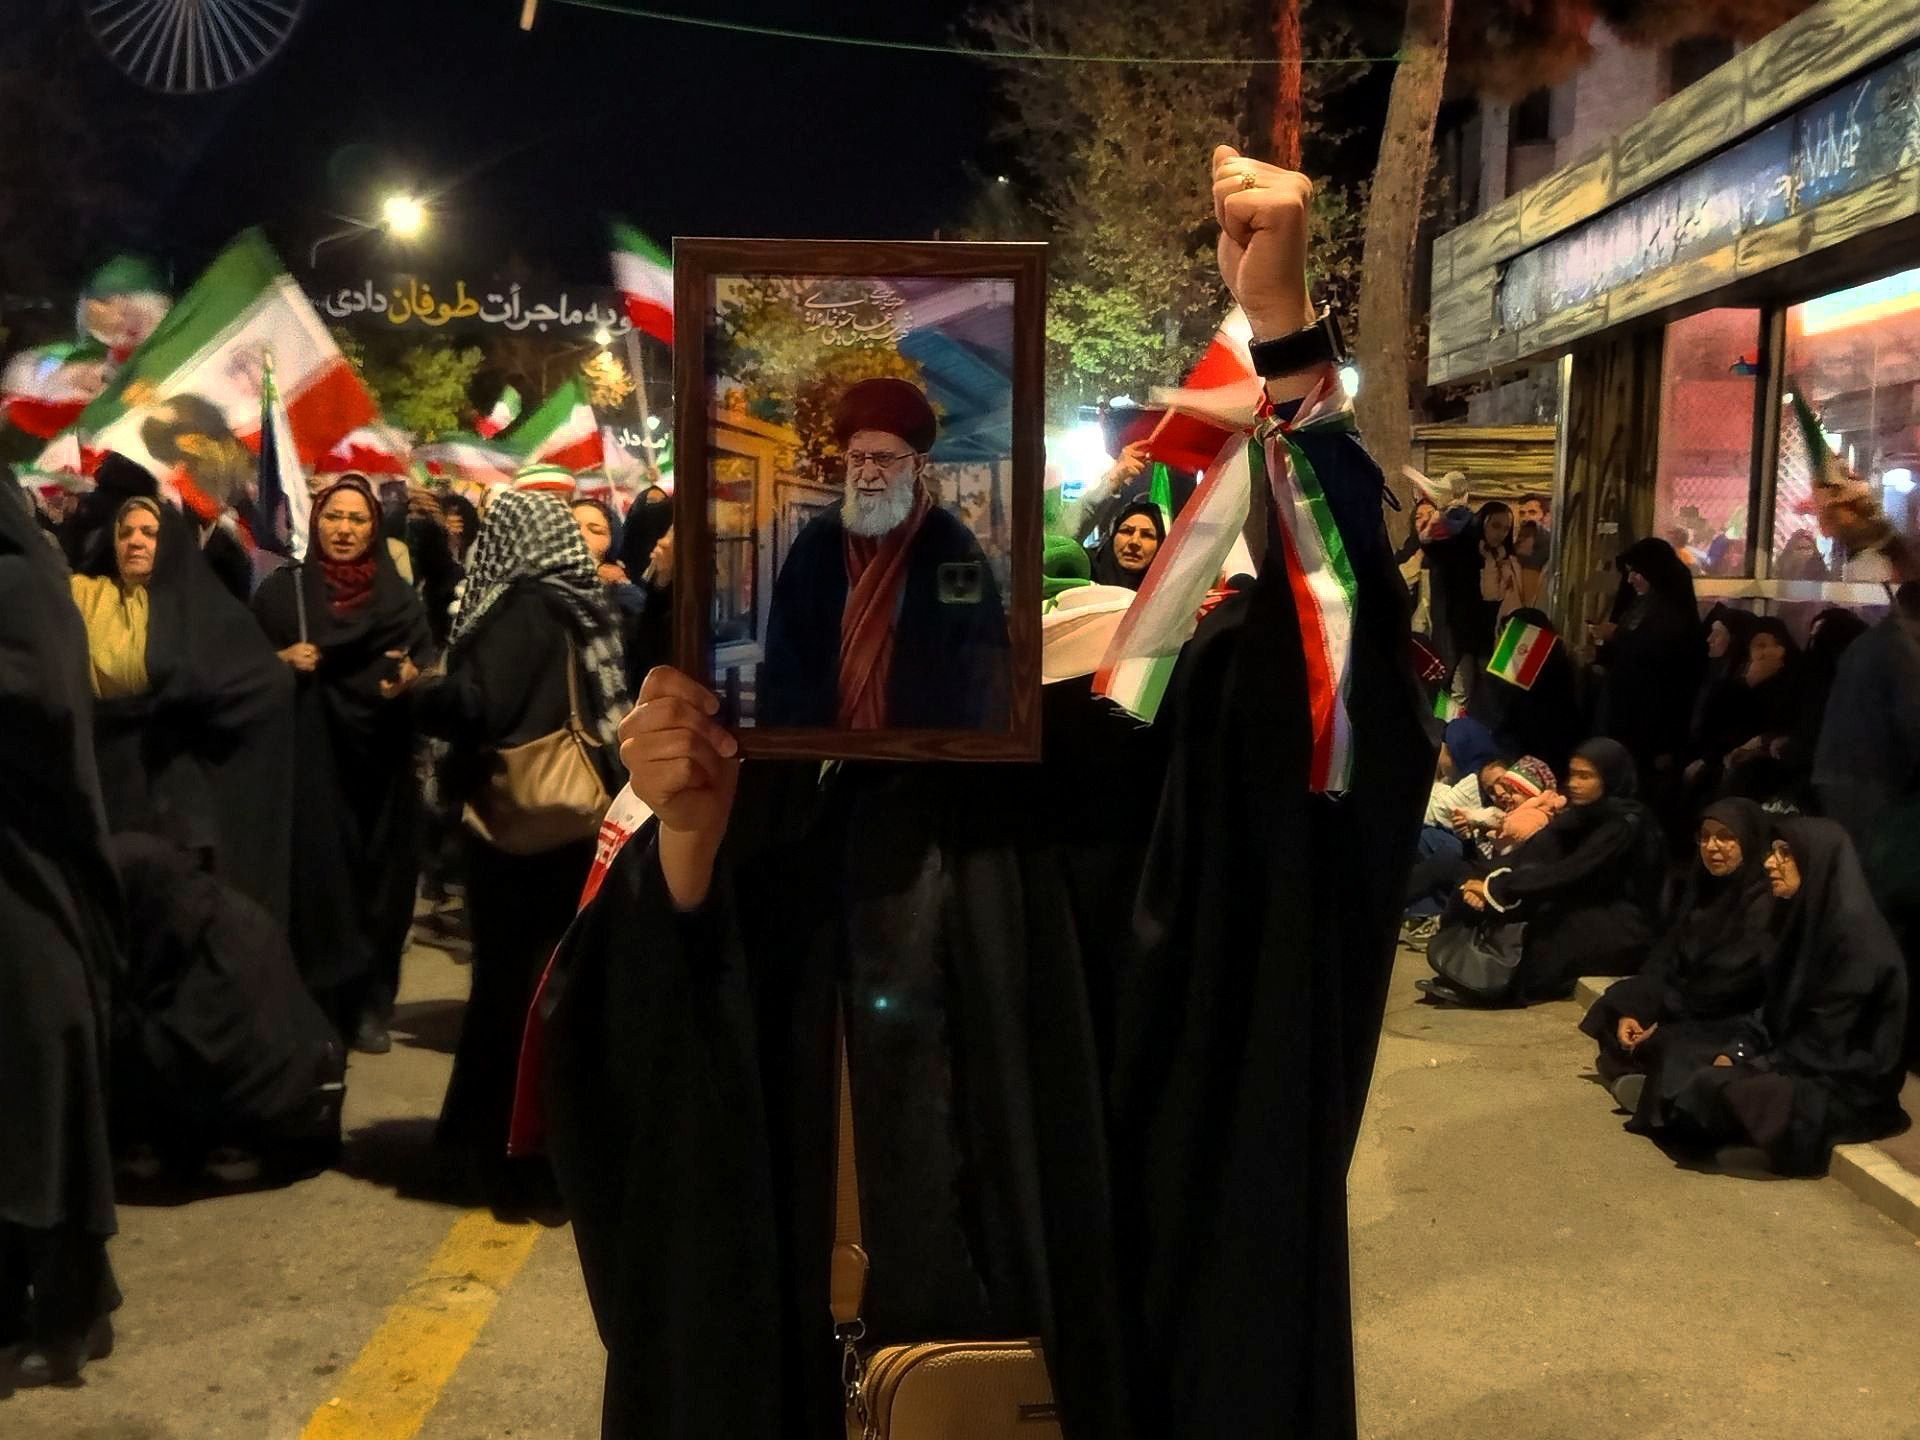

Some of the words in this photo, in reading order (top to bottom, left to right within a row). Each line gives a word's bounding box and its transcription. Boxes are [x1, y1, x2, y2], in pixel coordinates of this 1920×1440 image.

[325, 279, 388, 318] دادی
[386, 277, 480, 326] طوفان
[478, 282, 560, 332] جرأت
[559, 293, 584, 327] ما
